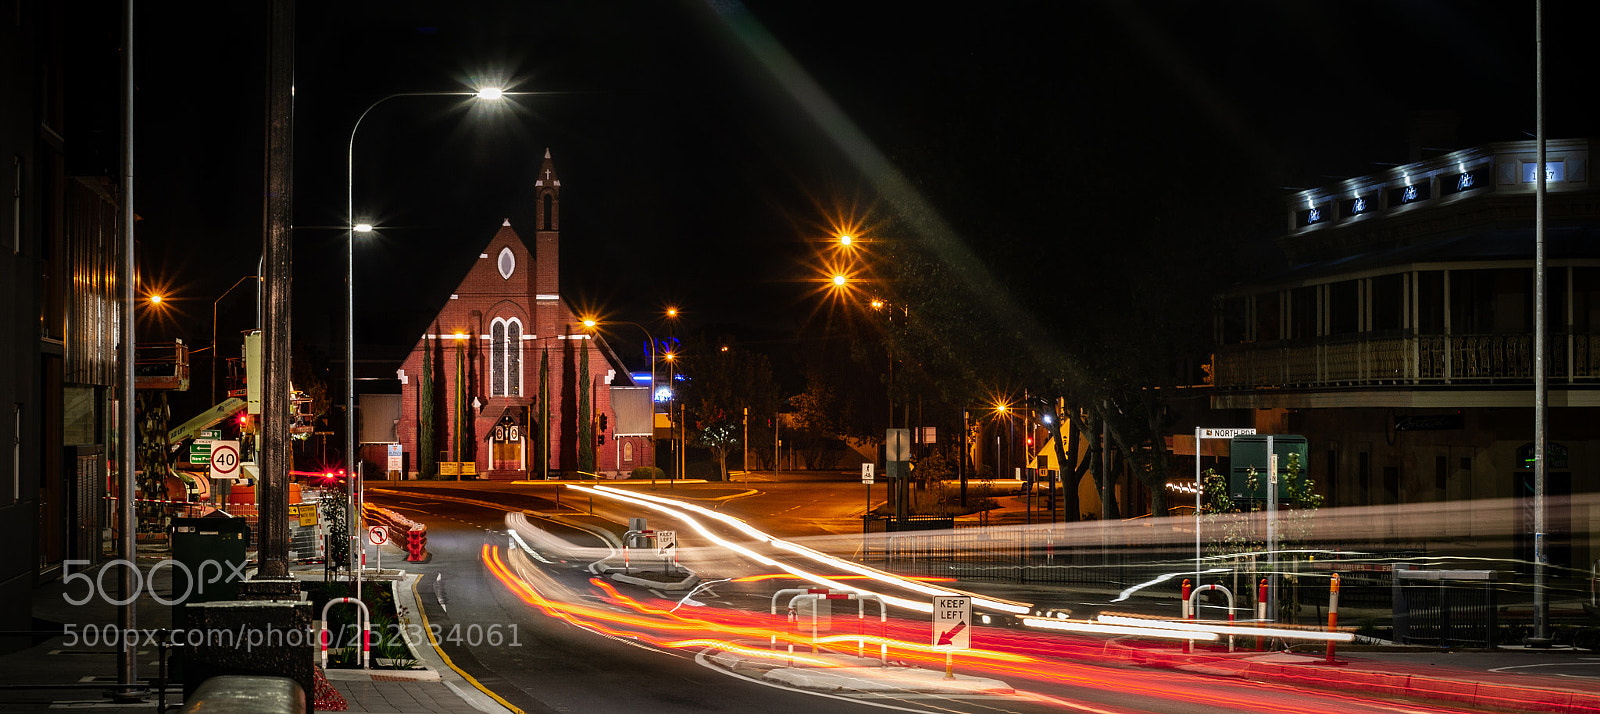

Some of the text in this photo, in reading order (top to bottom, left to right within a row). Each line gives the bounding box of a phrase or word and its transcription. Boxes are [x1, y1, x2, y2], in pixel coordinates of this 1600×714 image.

[1532, 171, 1555, 180] 17
[1214, 429, 1238, 437] NORTH
[216, 453, 235, 466] 40
[940, 599, 965, 608] KEEP
[941, 610, 964, 619] LEFT
